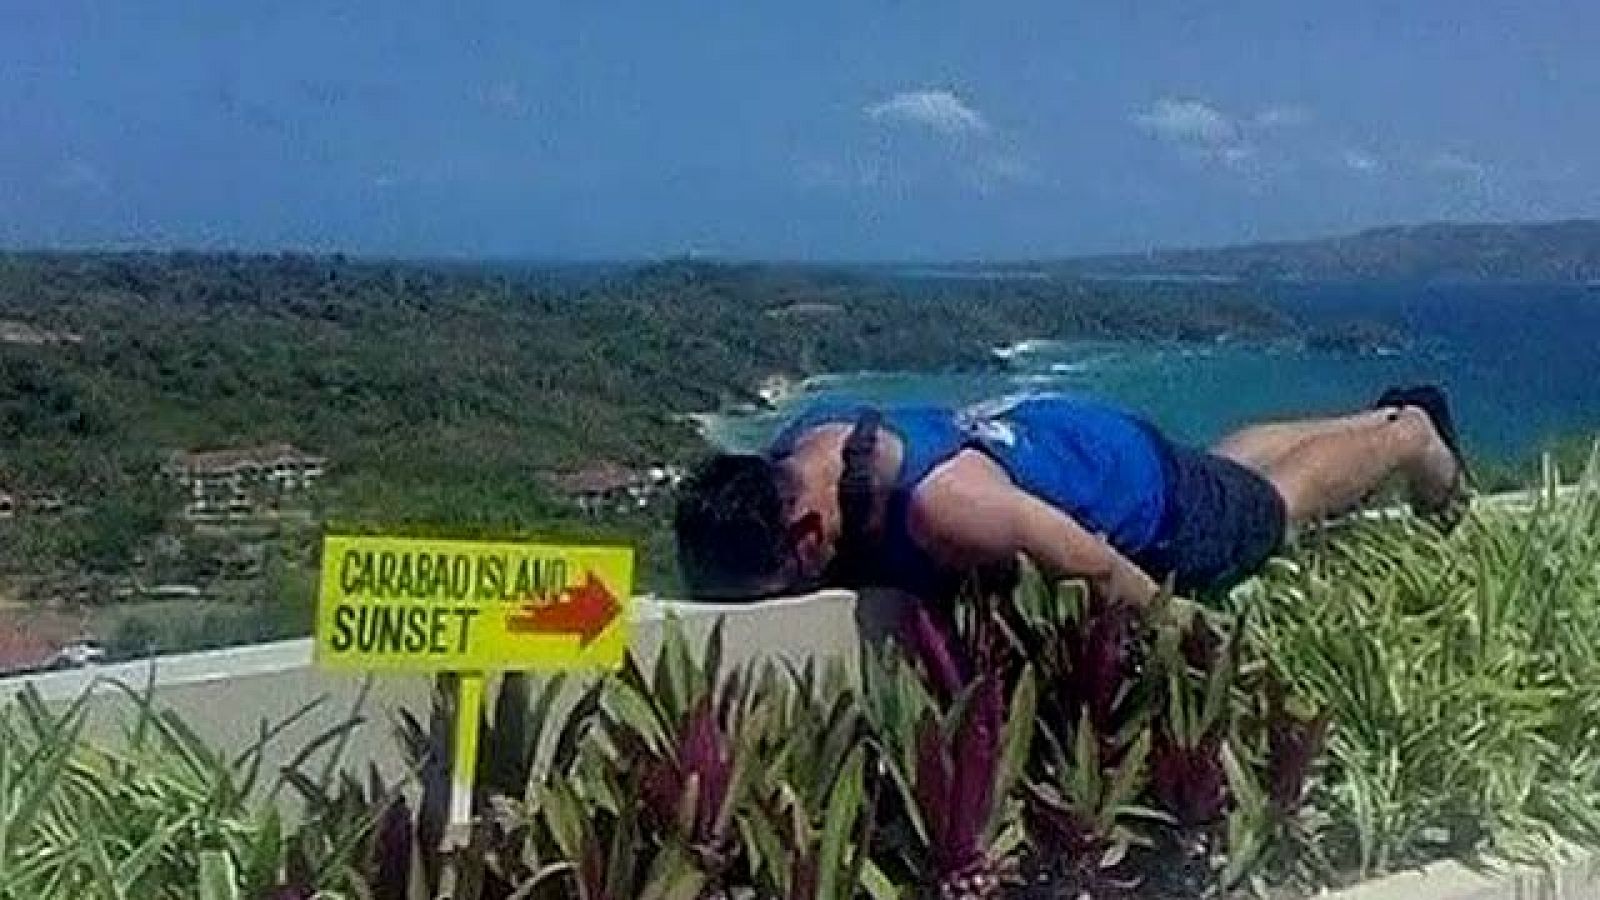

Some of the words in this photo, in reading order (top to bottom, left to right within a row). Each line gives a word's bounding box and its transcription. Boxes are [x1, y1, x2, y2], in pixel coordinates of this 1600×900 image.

[341, 549, 472, 600] CARABAO
[475, 553, 568, 601] ISLAND
[331, 604, 479, 653] SUNSET
